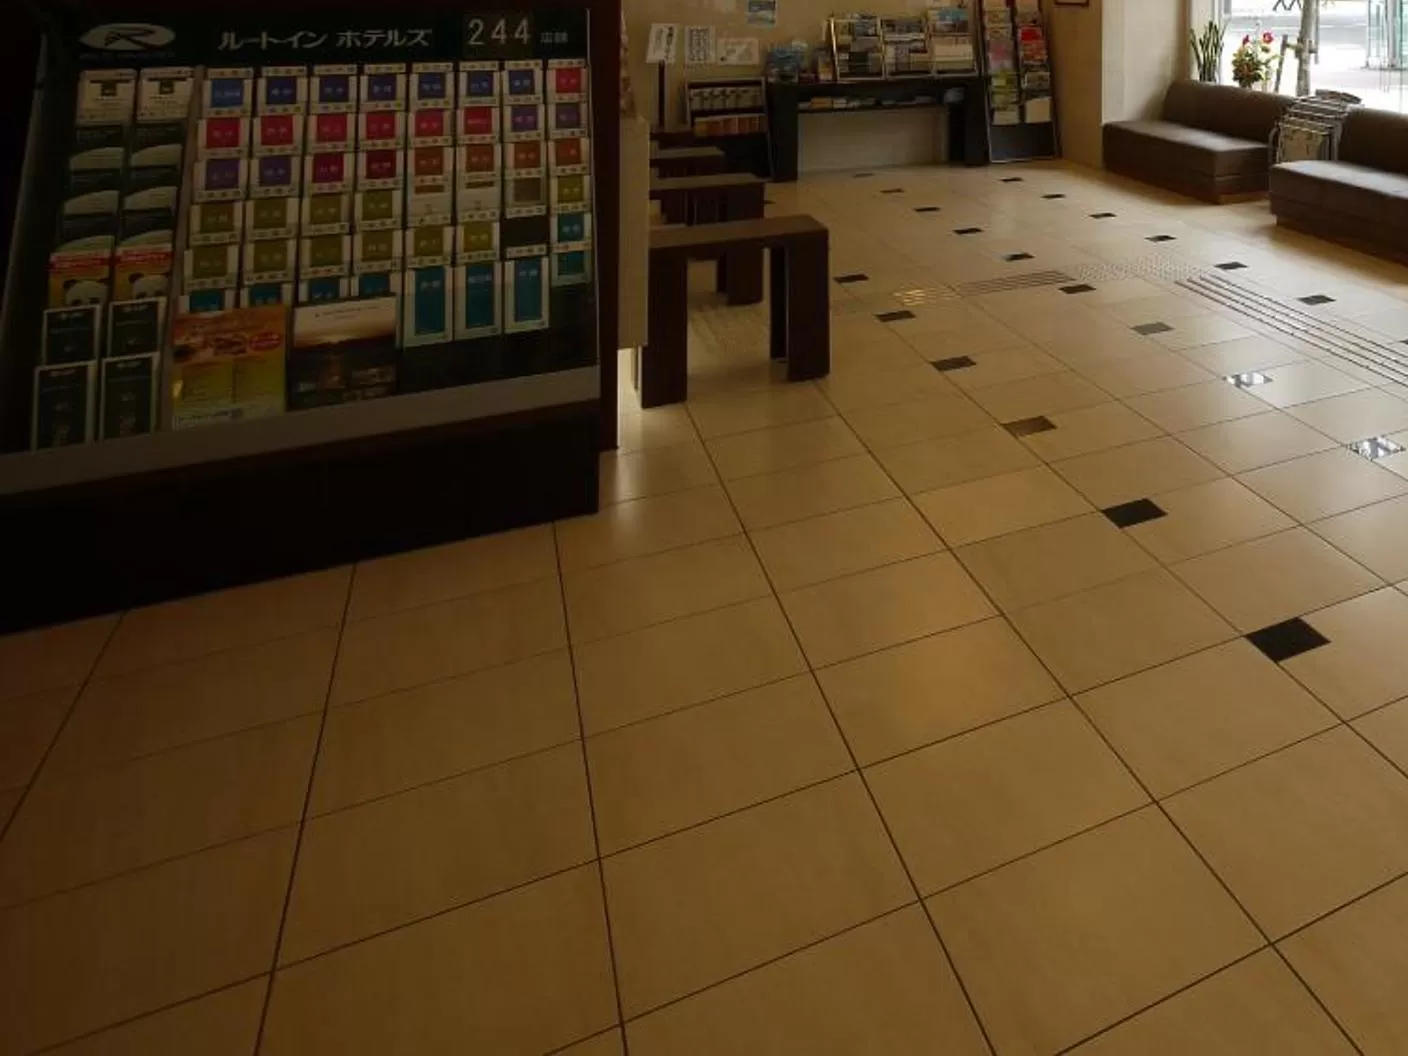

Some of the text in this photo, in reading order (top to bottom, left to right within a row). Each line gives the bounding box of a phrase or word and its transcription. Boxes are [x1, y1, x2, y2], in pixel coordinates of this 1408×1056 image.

[217, 29, 329, 52] ルートイン
[335, 27, 433, 49] ホテルズ
[467, 17, 532, 45] 244
